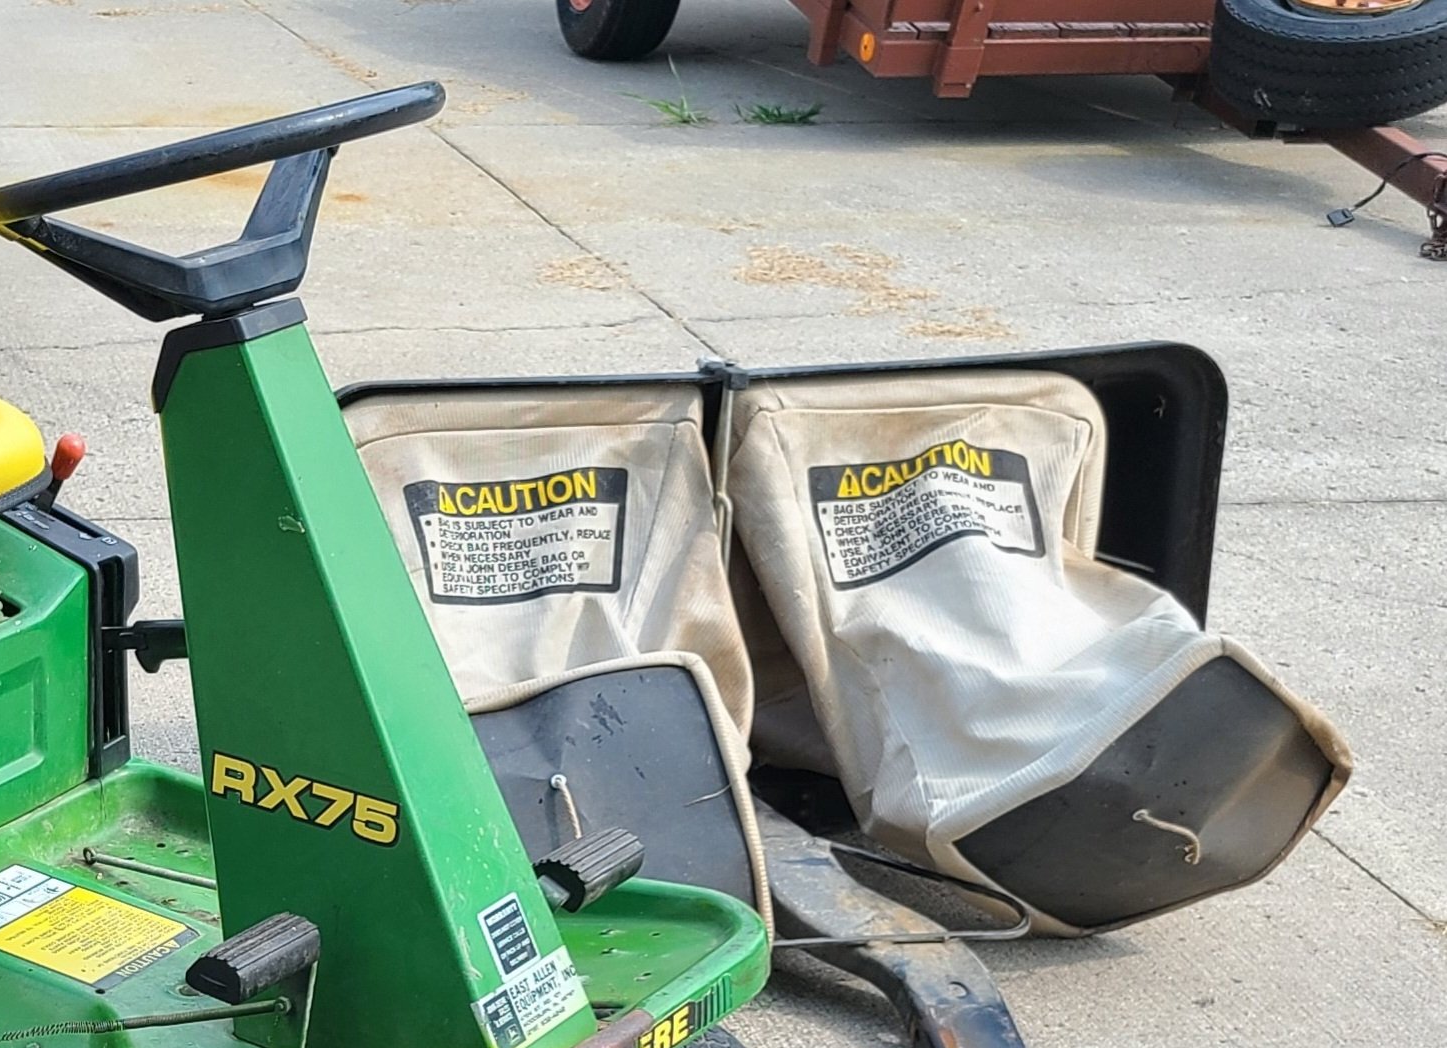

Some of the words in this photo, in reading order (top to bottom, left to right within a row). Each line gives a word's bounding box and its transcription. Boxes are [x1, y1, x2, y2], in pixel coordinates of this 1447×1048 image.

[861, 441, 991, 496] CAUTION
[455, 470, 596, 515] CAUTION
[855, 503, 865, 513] IS
[924, 470, 938, 481] TO
[464, 519, 514, 531] SUBJECT
[518, 517, 534, 528] TO
[538, 508, 574, 523] WEAR
[578, 506, 598, 517] AND
[835, 524, 872, 537] CHECK
[836, 535, 870, 547] WHEN
[872, 499, 938, 541] NECESSARY
[840, 547, 863, 559] USE
[878, 527, 906, 549] JOHN
[908, 505, 947, 530] DEERE
[464, 549, 531, 563] NECESSARY
[467, 543, 489, 552] BAG
[843, 533, 911, 569] EQUIVALENT
[915, 523, 930, 536] TO
[466, 564, 494, 574] JOHN
[498, 558, 537, 572] DEERE
[541, 551, 568, 565] BAG
[502, 573, 519, 582] TO
[523, 562, 573, 580] COMPLY
[847, 558, 891, 579] SAFETY
[477, 573, 575, 595] SPECIFICATIONS
[212, 753, 398, 844] RX75
[115, 946, 171, 977] CAUTION
[509, 978, 530, 999] EAST
[533, 960, 557, 984] ALLEN
